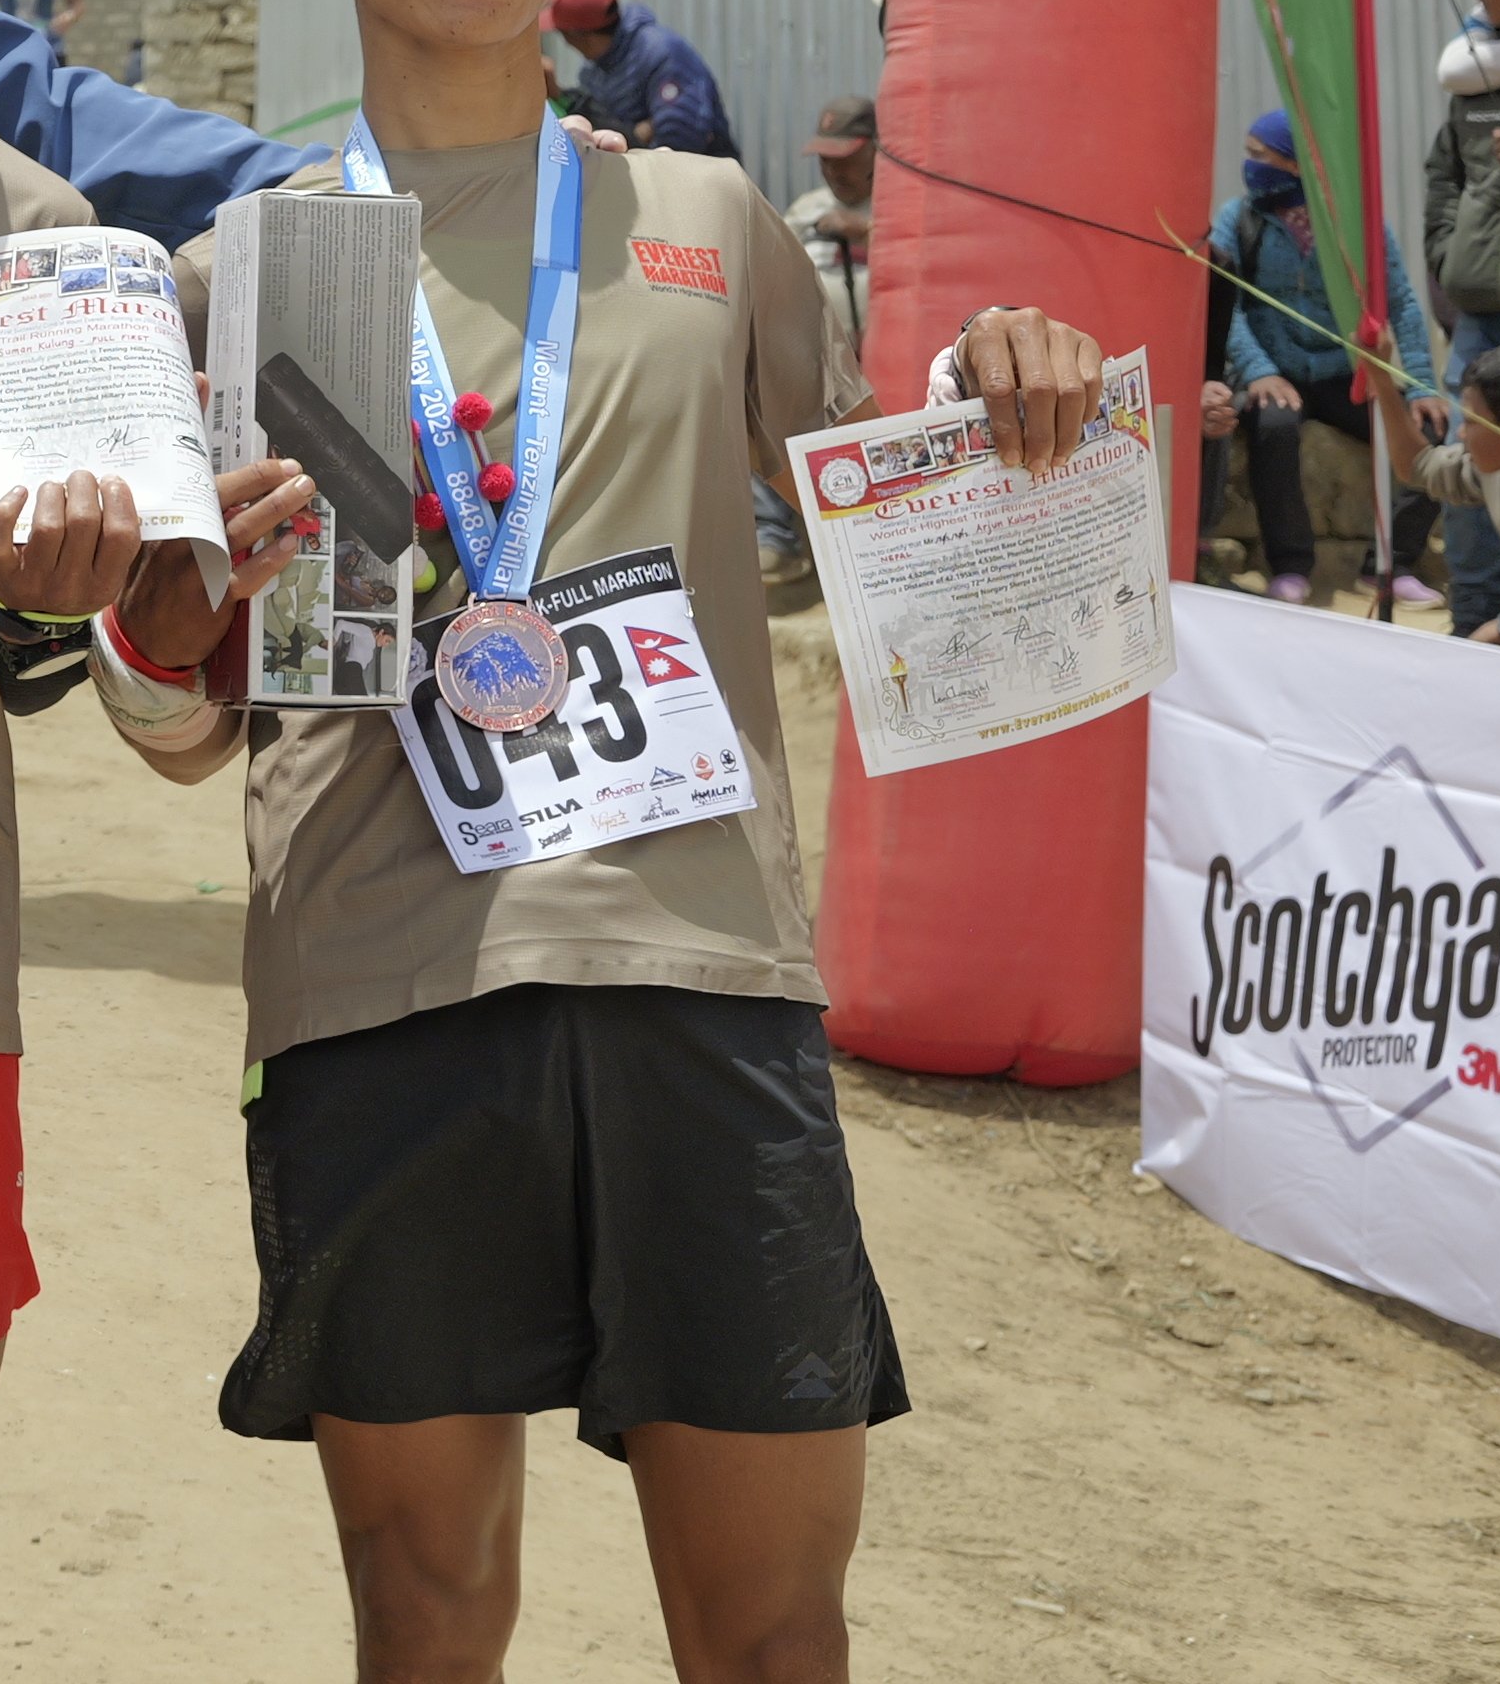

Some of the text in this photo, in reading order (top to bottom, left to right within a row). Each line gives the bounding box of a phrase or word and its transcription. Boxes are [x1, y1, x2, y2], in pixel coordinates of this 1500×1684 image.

[631, 240, 723, 274] EVEREST
[642, 262, 729, 298] MARATHON
[1, 335, 25, 344] Trail
[39, 339, 74, 351] Kulung
[528, 339, 561, 419] Mount
[420, 390, 455, 450] 2025
[869, 483, 1085, 542] World's Highest Trail Running Marathon
[874, 476, 1015, 520] Everest
[975, 521, 1004, 536] Arjun
[880, 552, 913, 564] NEPAL
[534, 561, 674, 617] K-FULL MARATHON
[457, 798, 584, 846] Seara SILVA
[487, 841, 505, 852] 3M
[1321, 1033, 1418, 1070] PROTECTOR
